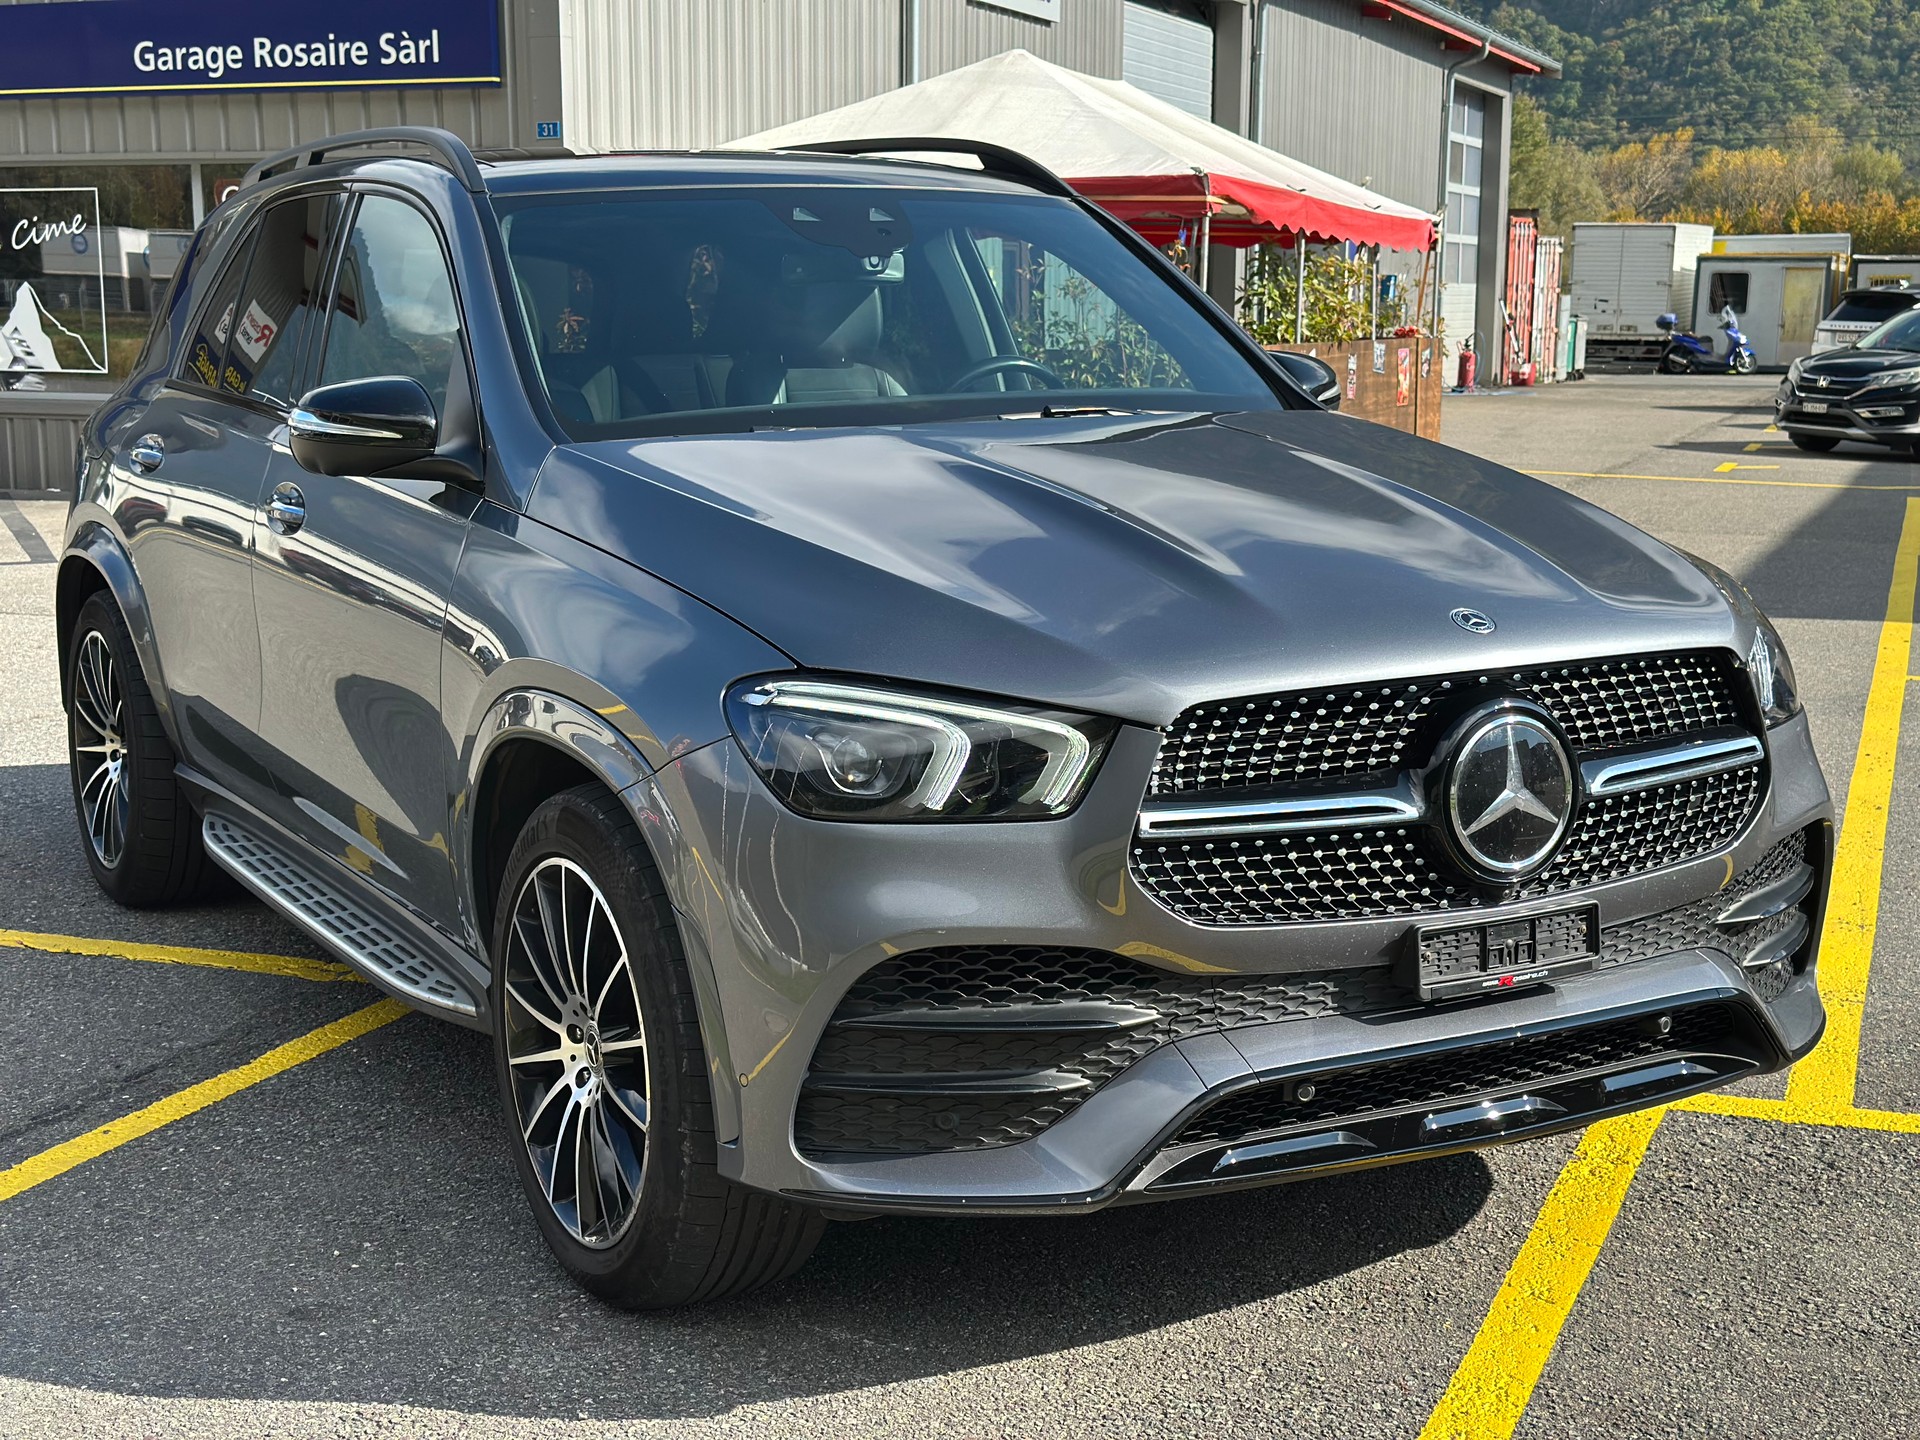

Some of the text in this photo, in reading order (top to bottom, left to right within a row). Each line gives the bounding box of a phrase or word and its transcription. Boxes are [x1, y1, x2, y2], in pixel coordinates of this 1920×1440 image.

[133, 29, 440, 78] Garage Rosaire Sàrl
[541, 123, 554, 136] 31
[11, 213, 87, 250] Cime
